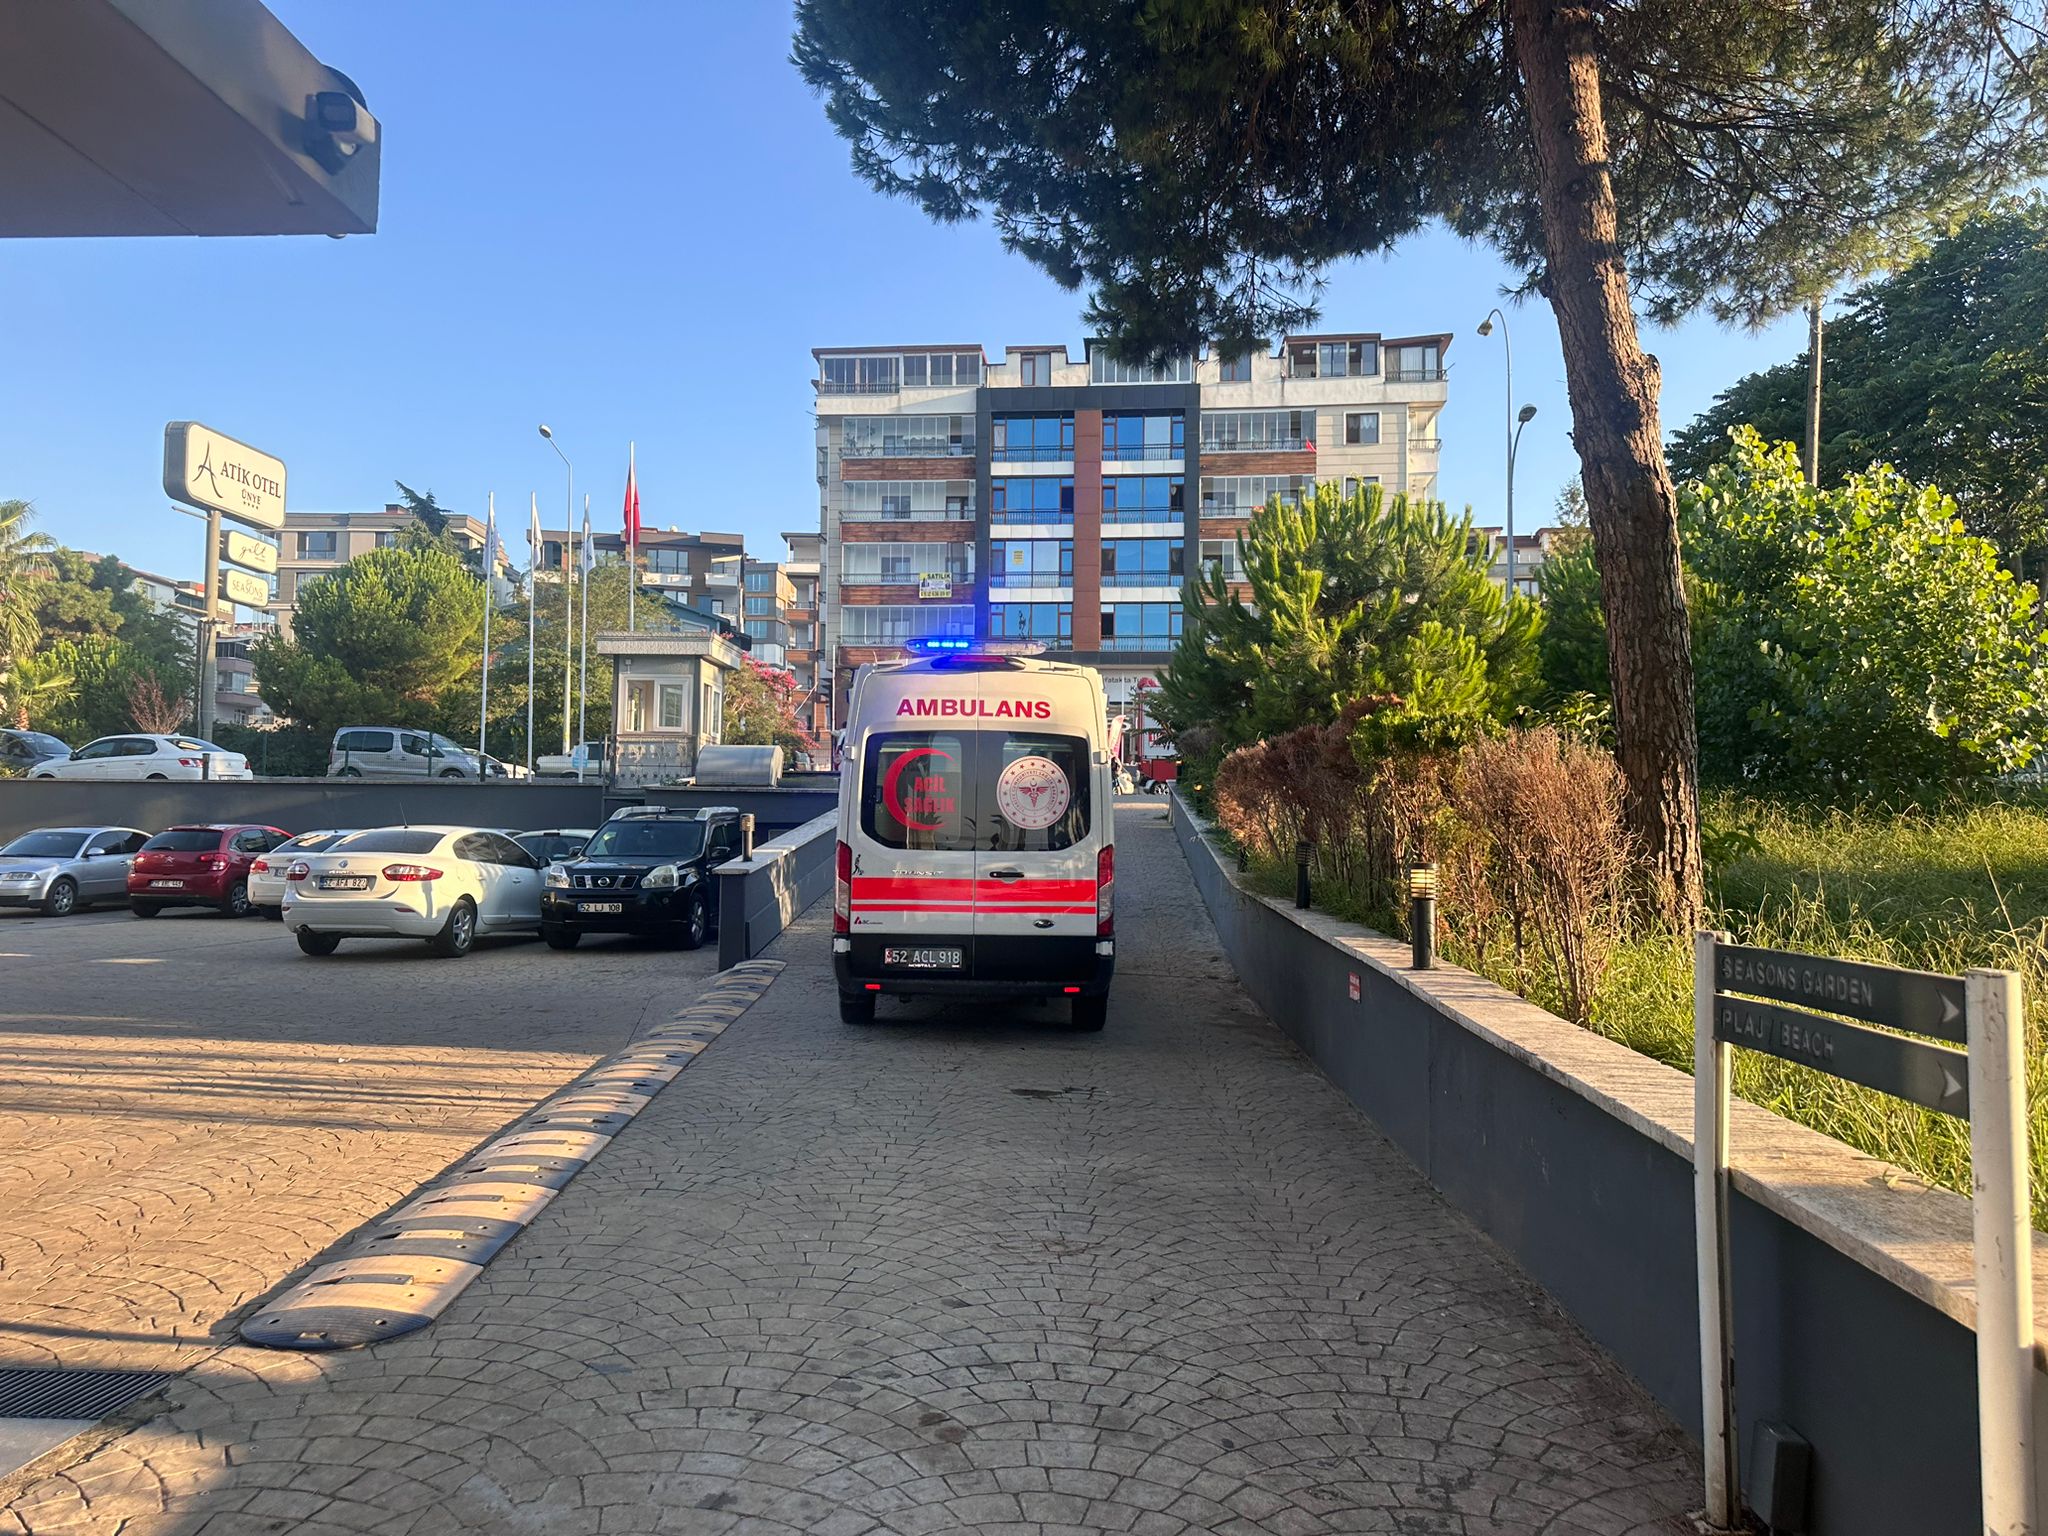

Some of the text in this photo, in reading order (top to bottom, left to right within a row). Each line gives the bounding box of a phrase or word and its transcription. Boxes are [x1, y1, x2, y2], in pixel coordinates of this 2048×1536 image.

[220, 461, 282, 499] ATİK OTEL
[241, 488, 262, 505] ÜNYE
[232, 580, 263, 598] SEASONS
[896, 698, 1051, 719] AMBULANS
[914, 774, 946, 792] ACİL
[904, 794, 956, 813] SAĞLIK
[336, 878, 348, 887] AFA
[893, 951, 960, 964] 52 ACL 918
[1722, 955, 1873, 1007] SEASONS GARDEN
[1721, 1007, 1765, 1038] PLAJ
[1781, 1022, 1834, 1057] BEACH
